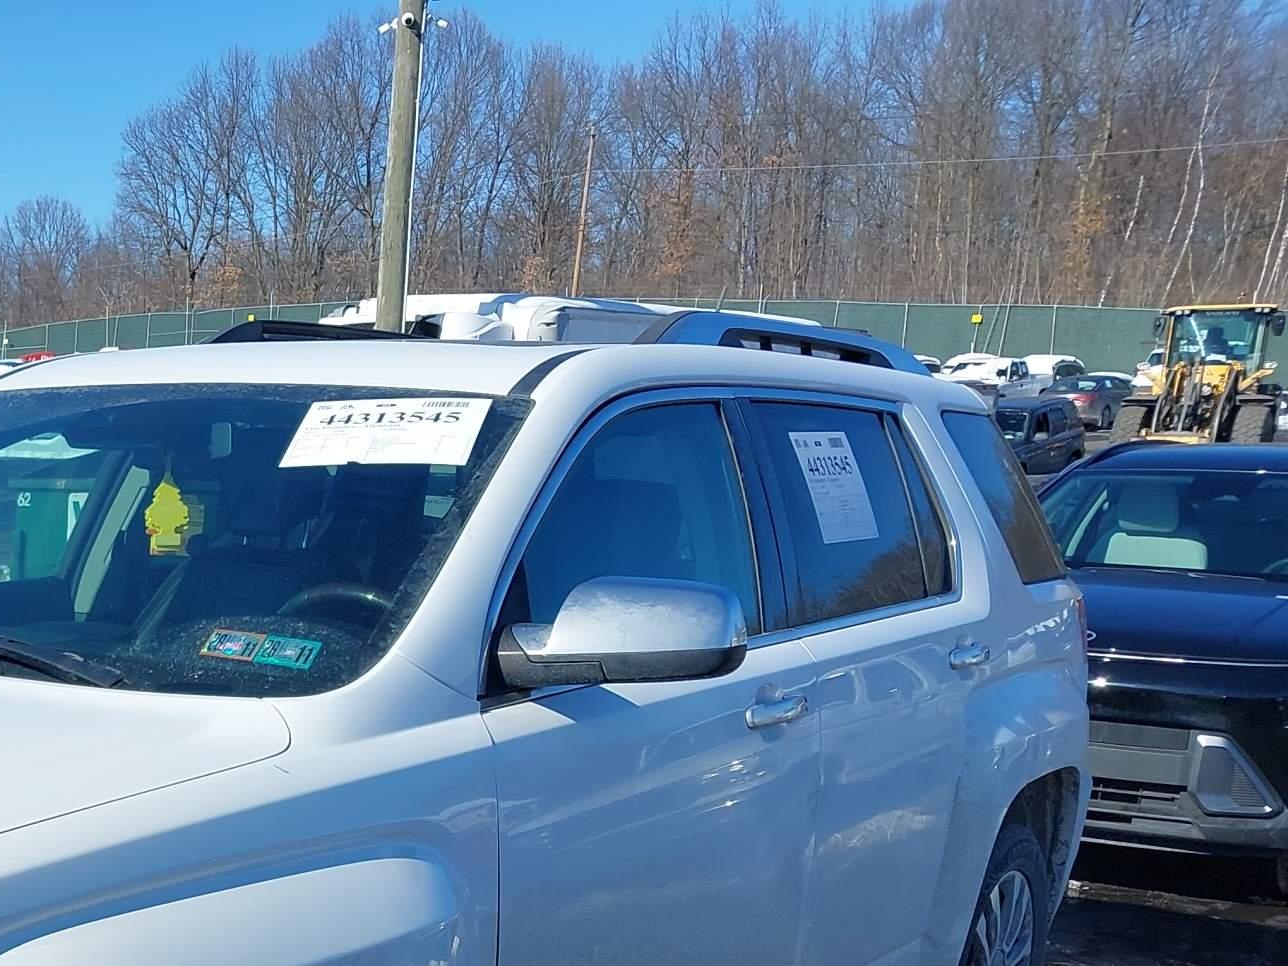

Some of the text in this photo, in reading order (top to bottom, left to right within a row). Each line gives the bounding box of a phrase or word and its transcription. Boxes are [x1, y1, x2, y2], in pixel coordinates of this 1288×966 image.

[319, 411, 463, 426] 44313545
[807, 455, 853, 476] 44313545
[17, 492, 31, 507] 62
[295, 645, 314, 664] 11
